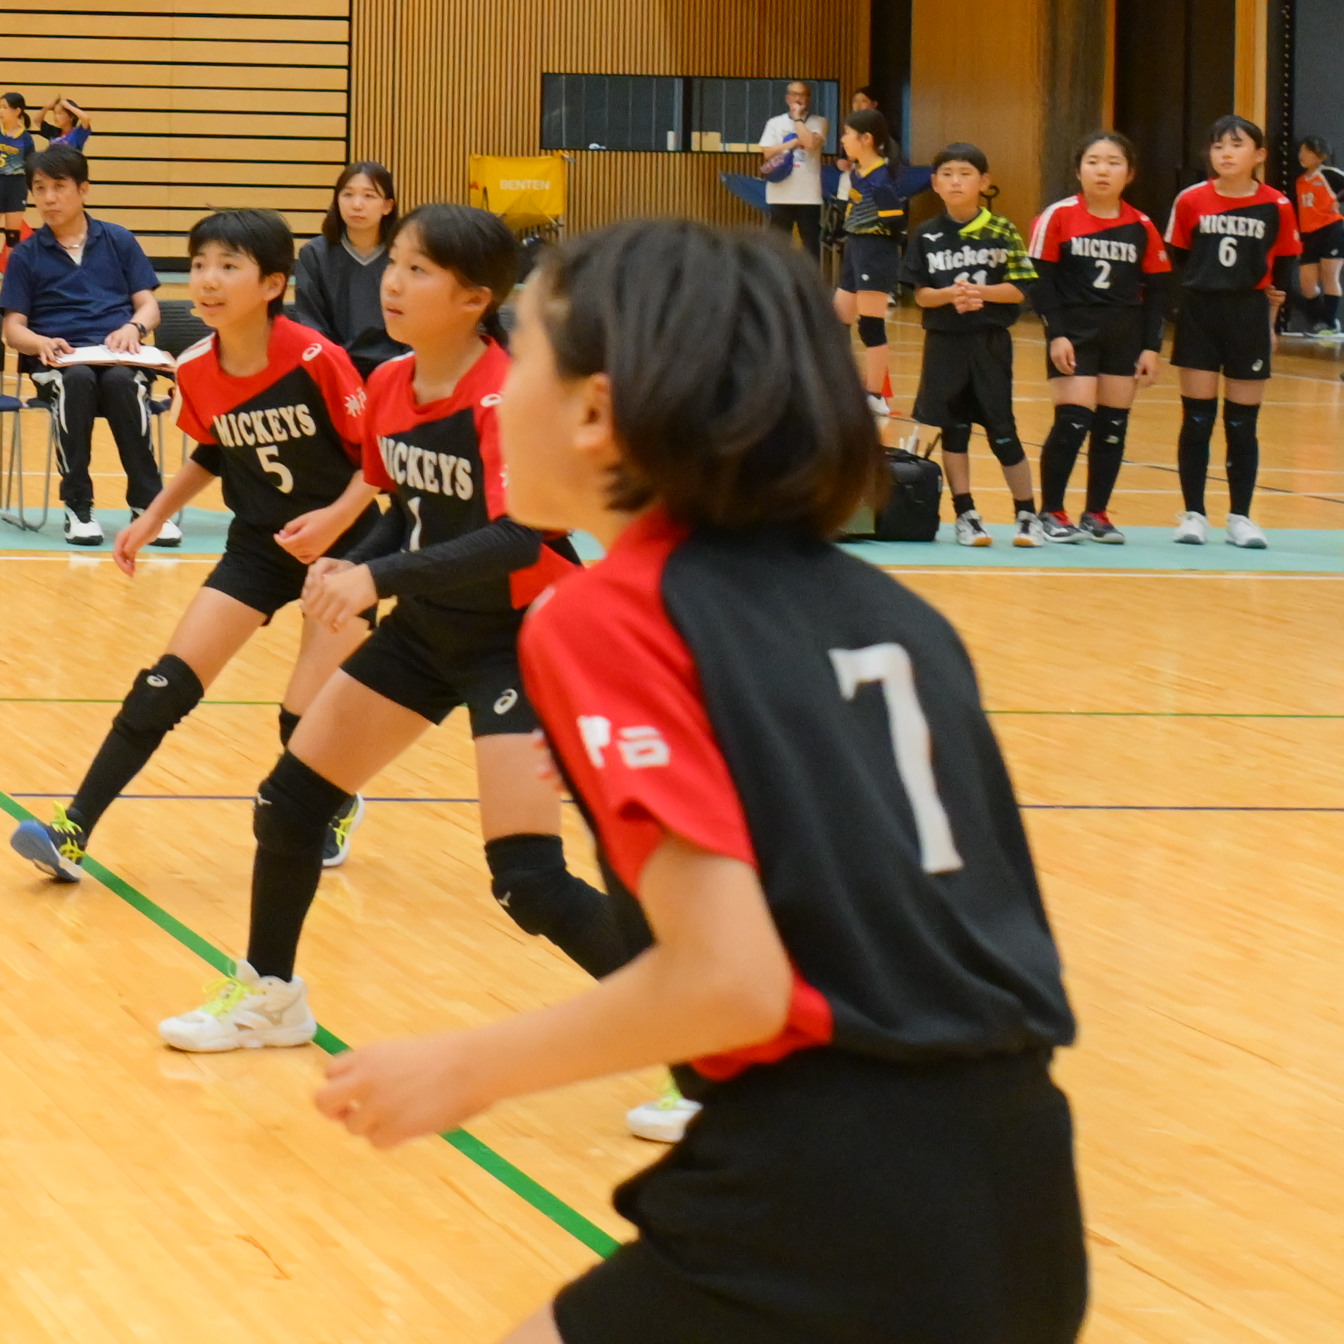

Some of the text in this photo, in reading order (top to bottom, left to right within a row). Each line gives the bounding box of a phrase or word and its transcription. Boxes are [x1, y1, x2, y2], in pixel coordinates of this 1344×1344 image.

[1199, 214, 1266, 239] MICKEYS
[926, 245, 1008, 274] Mickeys
[1071, 236, 1137, 263] MICKEYS
[1218, 236, 1238, 267] 6
[1093, 259, 1111, 289] 2
[213, 403, 317, 448] MICKEYS
[255, 445, 294, 494] 5
[407, 496, 422, 551] 1
[828, 642, 964, 875] 7
